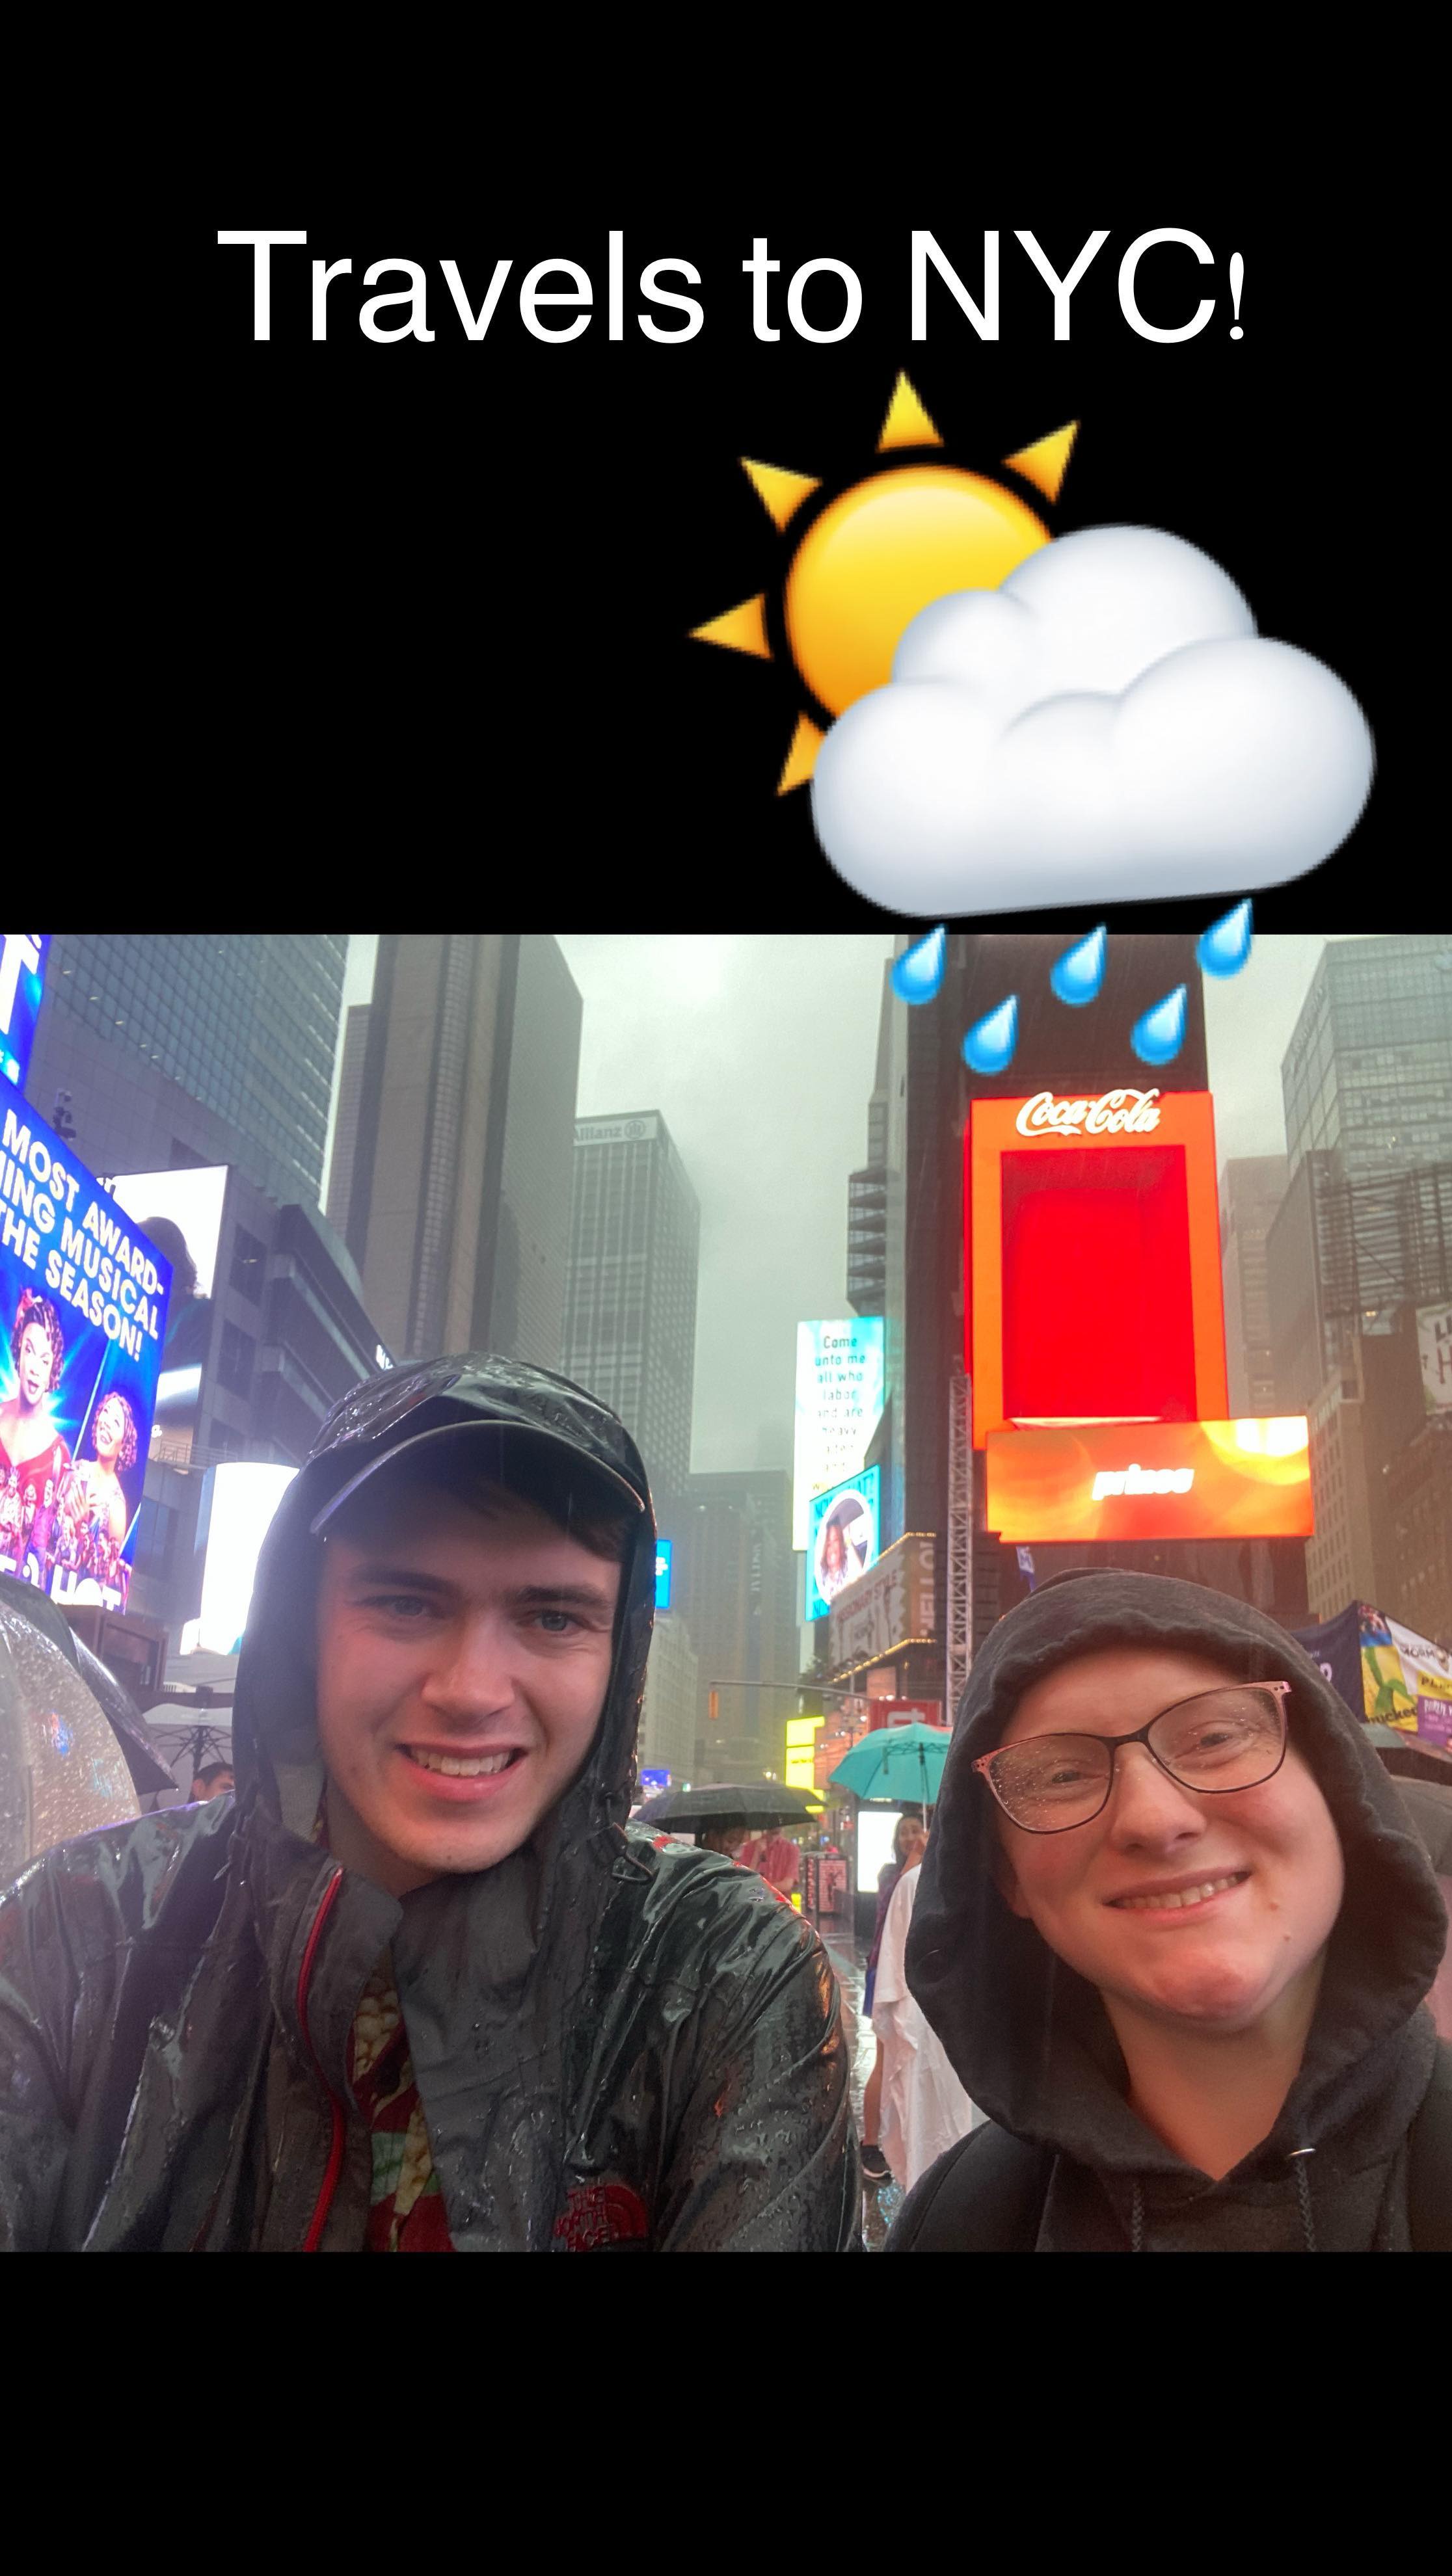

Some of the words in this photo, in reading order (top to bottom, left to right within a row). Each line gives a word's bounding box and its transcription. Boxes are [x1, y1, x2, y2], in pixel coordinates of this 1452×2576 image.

[2, 1108, 79, 1212] MOST
[83, 1201, 164, 1295] AWARD-
[45, 1249, 142, 1362] SEASON!
[60, 1217, 159, 1340] MUSICAL
[815, 1355, 841, 1366] unto
[848, 1355, 865, 1364] me
[823, 1336, 857, 1349] Come
[817, 1370, 832, 1384] all
[838, 1370, 863, 1382] who
